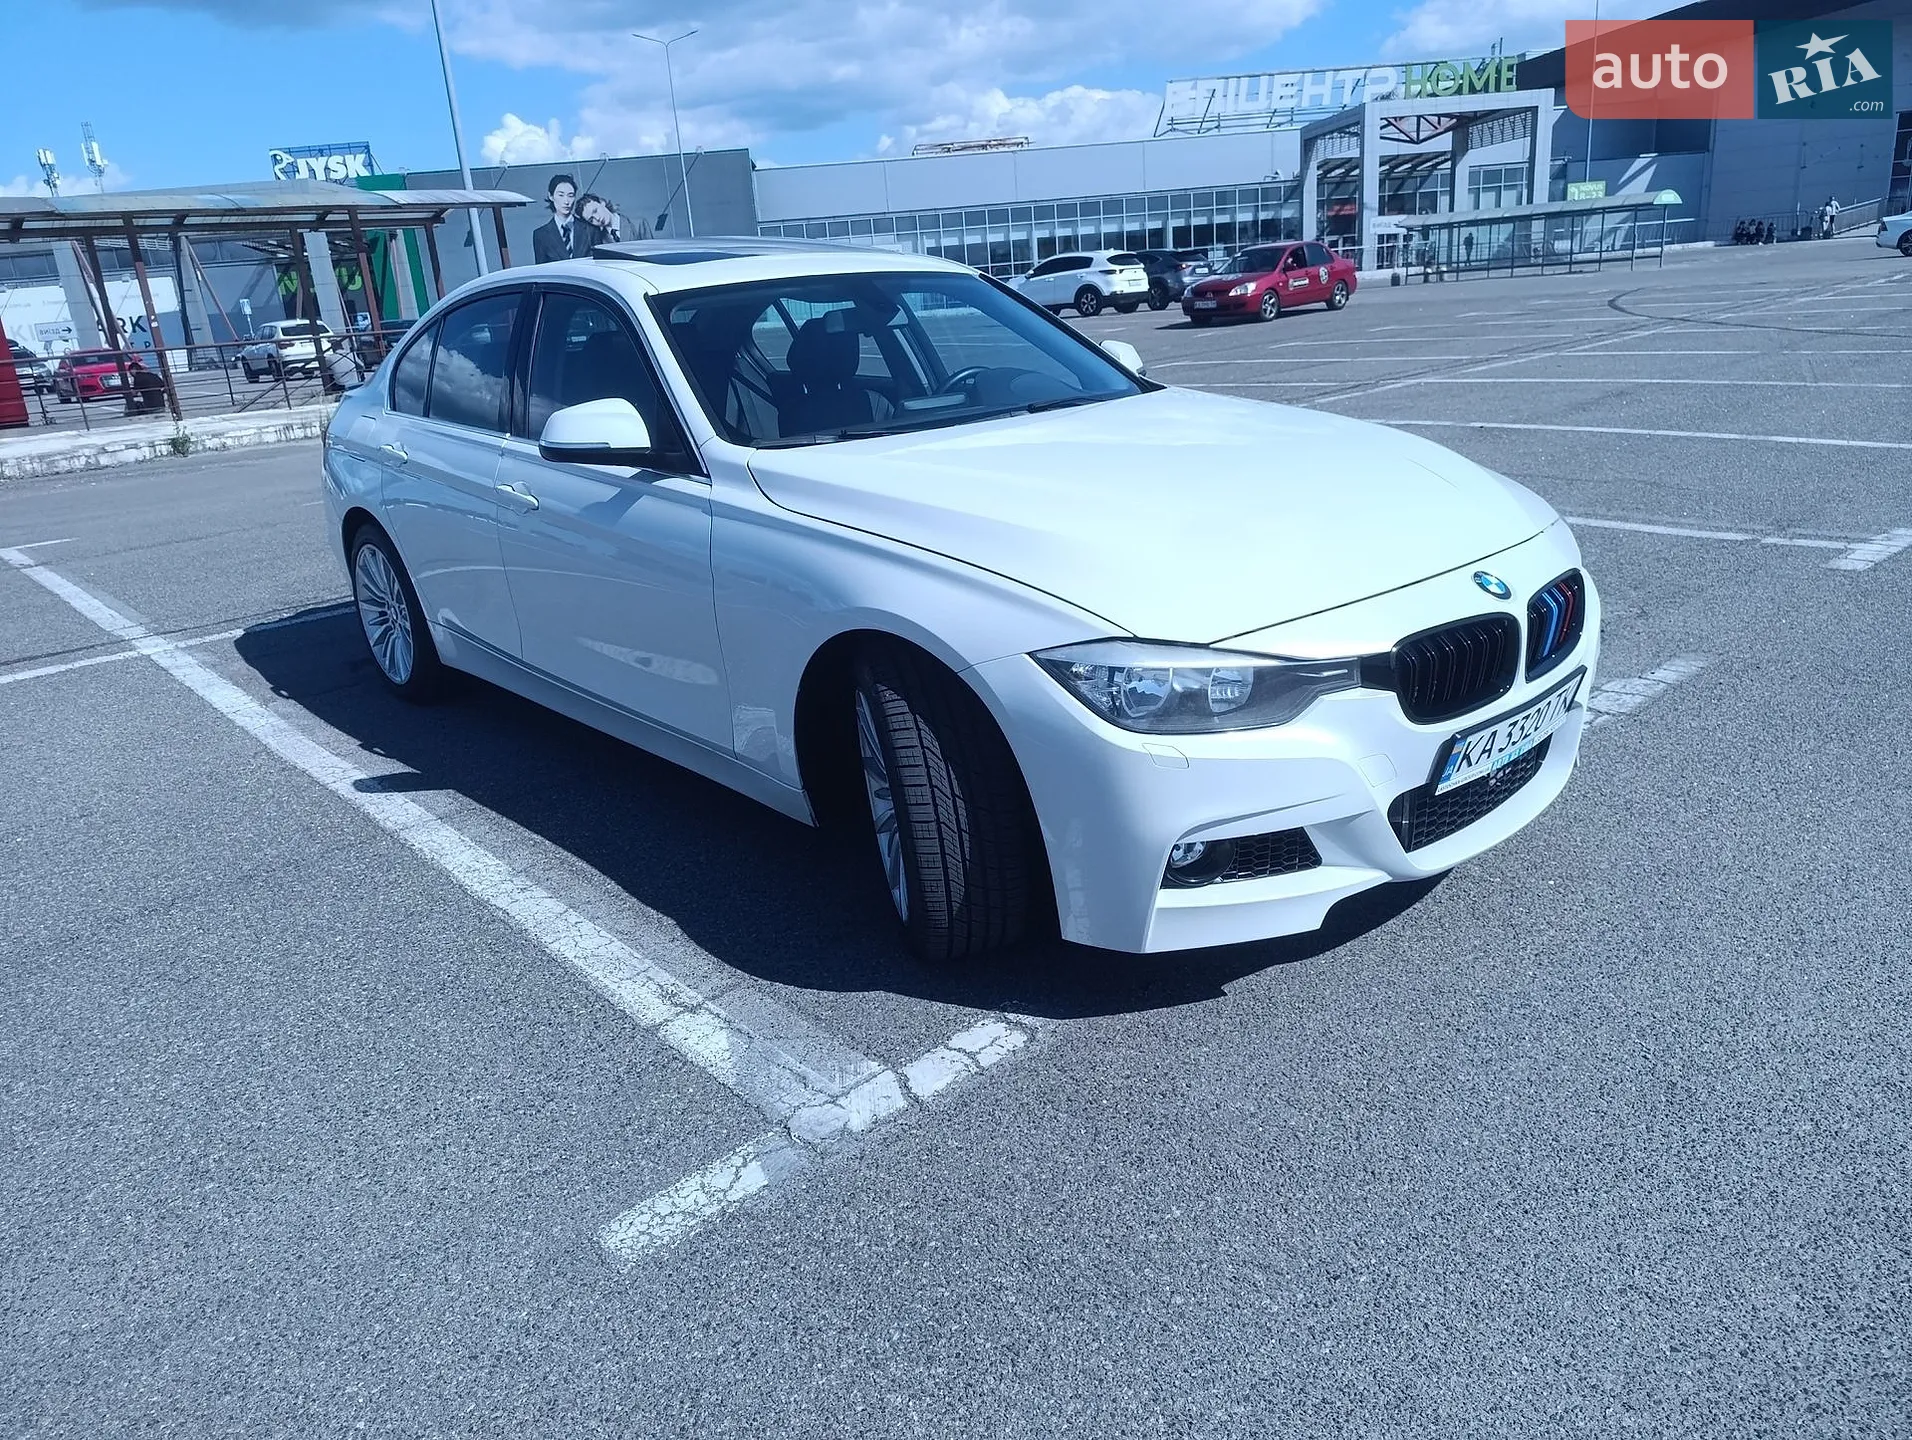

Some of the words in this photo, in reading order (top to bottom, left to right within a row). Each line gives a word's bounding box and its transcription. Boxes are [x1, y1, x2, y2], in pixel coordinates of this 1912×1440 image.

[1404, 56, 1518, 100] HOME
[295, 153, 372, 181] JYSK
[1456, 729, 1498, 774] KA
[1498, 700, 1552, 753] 3320
